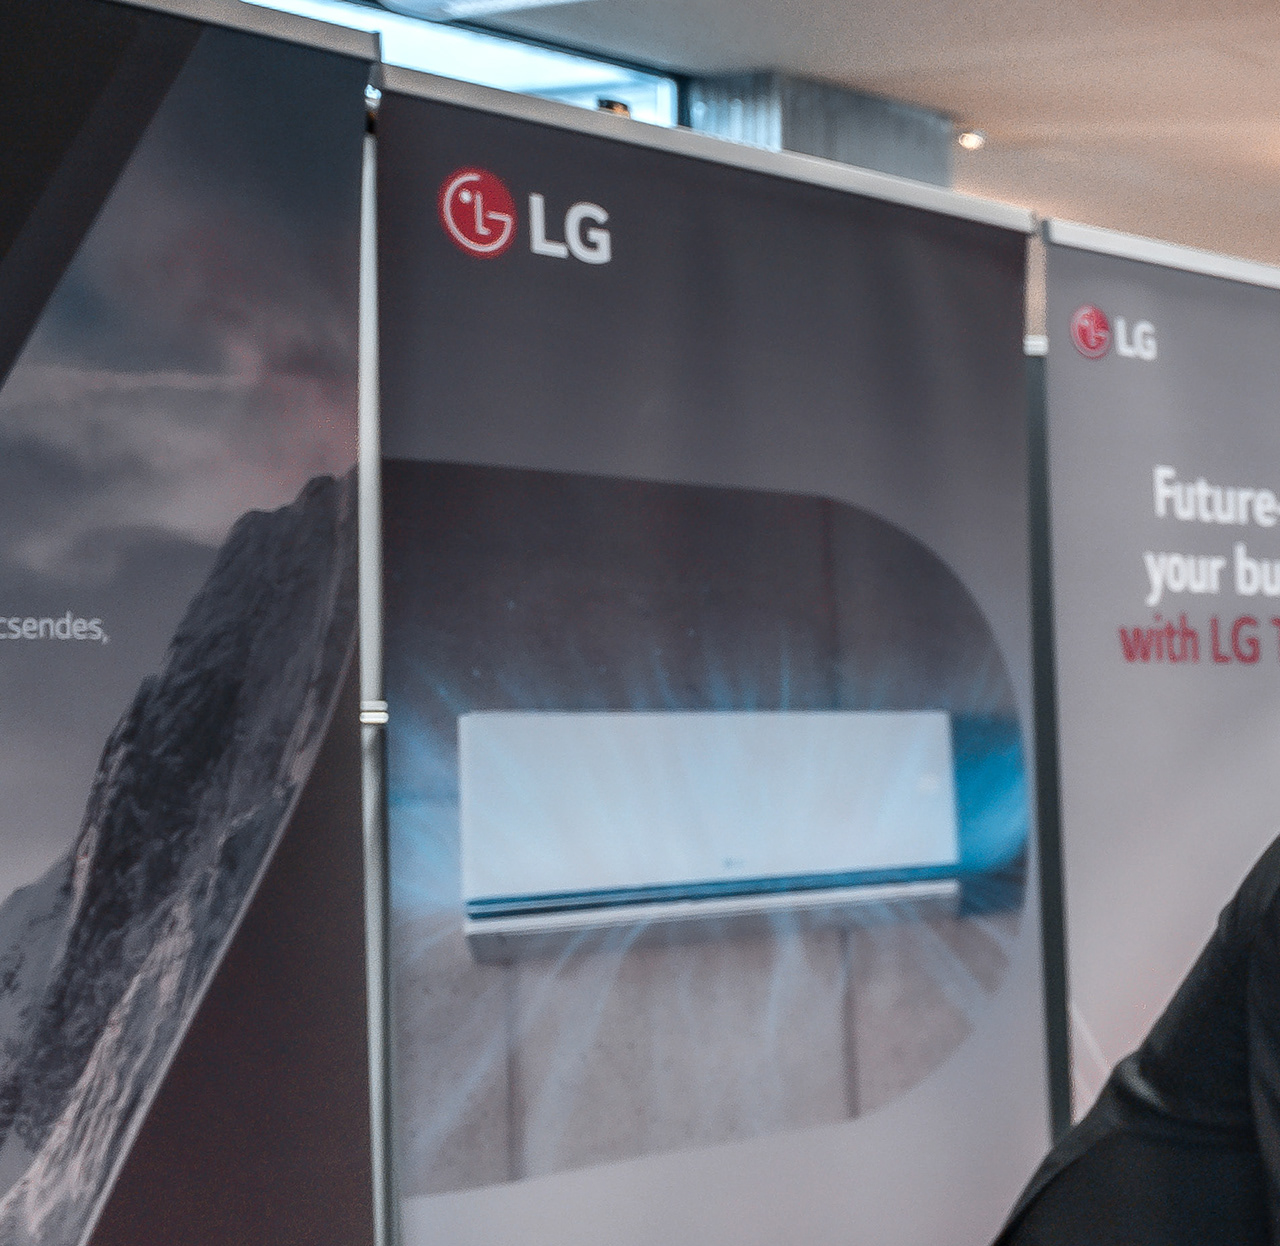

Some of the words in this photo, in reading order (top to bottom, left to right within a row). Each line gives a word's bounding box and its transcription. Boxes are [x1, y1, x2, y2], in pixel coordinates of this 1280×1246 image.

[528, 192, 612, 265] LG
[1113, 314, 1158, 361] LG
[1143, 550, 1228, 608] your
[1119, 613, 1200, 665] with
[1209, 615, 1261, 665] LG
